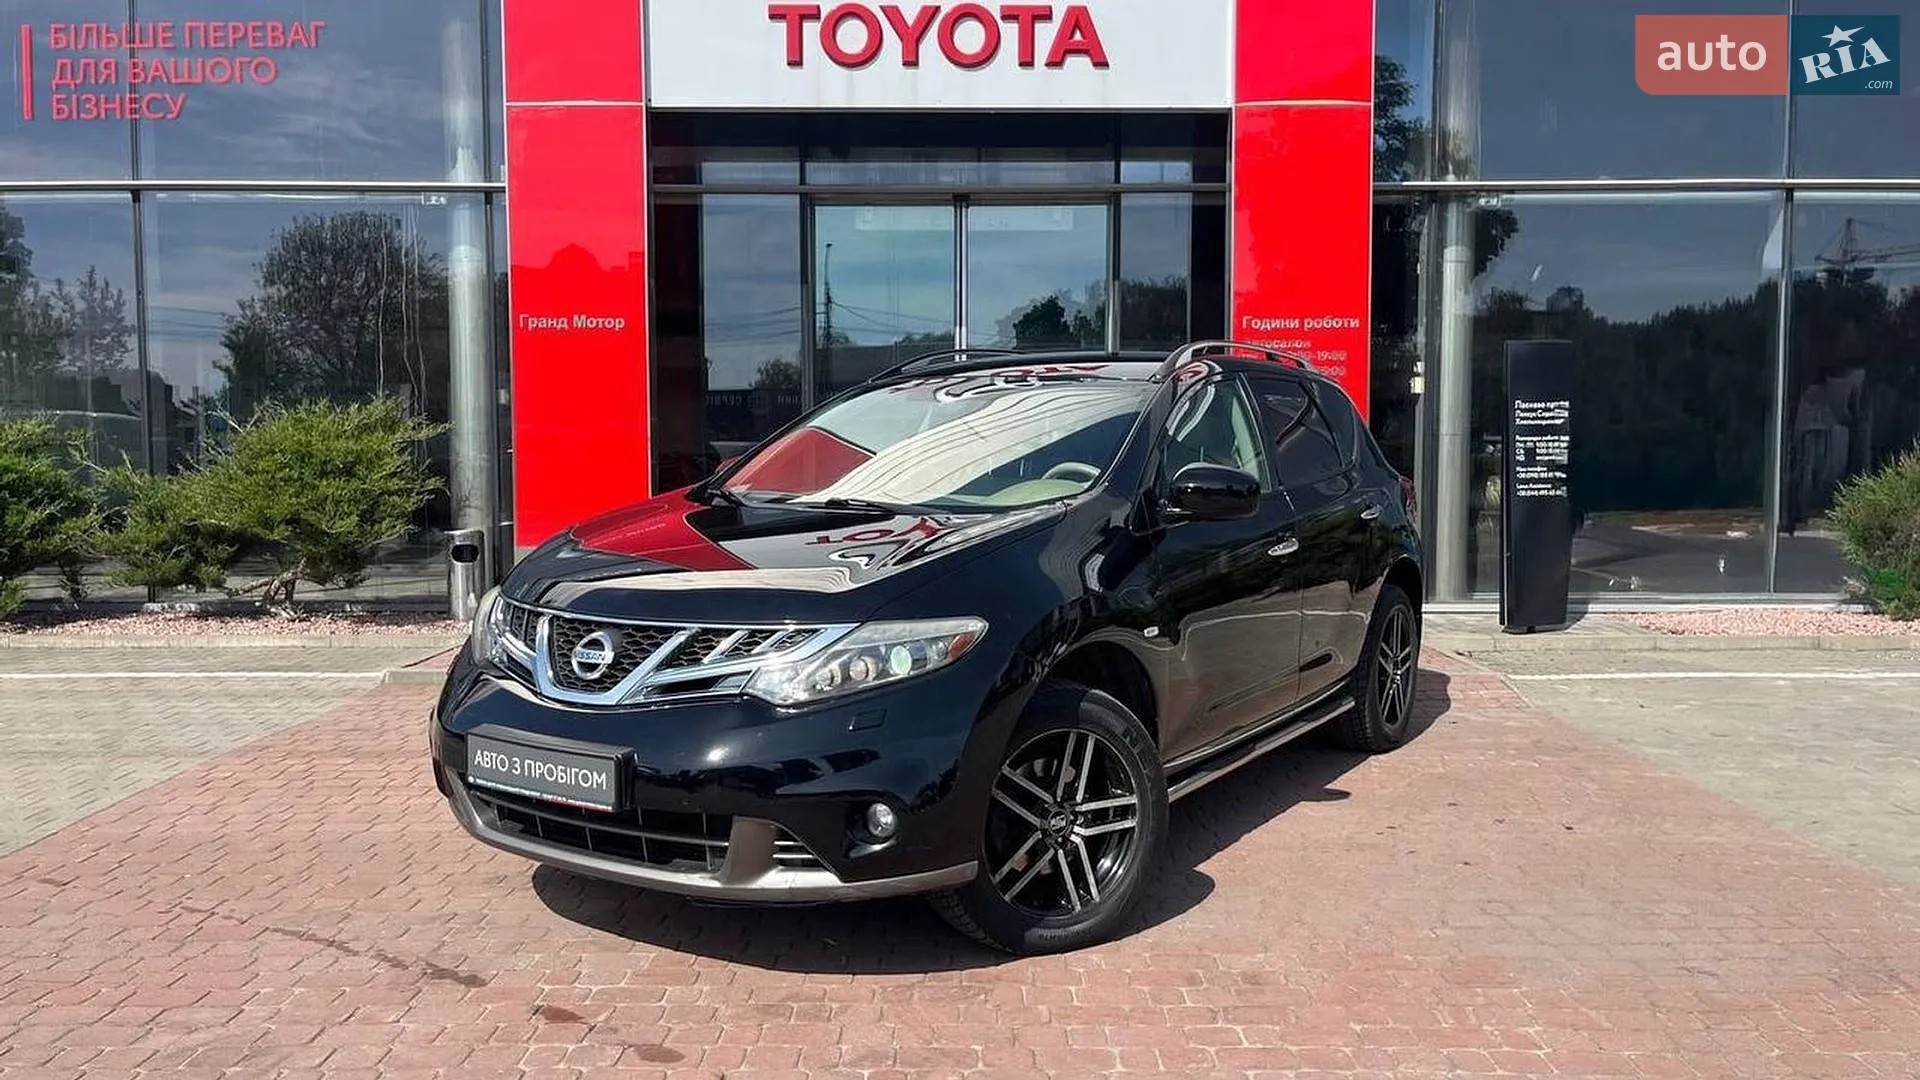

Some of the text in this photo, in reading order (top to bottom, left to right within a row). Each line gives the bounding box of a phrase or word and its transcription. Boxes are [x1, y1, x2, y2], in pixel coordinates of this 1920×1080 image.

[50, 20, 326, 49] БІЛЬШЕ ПЕРЕВАГ
[768, 2, 1110, 69] TOYOTA
[52, 56, 278, 90] ДЛЯ ВАШОГО
[51, 92, 188, 121] БІЗНЕСУ
[519, 314, 625, 331] Гранд Мотор
[1242, 315, 1360, 331] Години роботи
[474, 750, 509, 773] АВТО
[524, 759, 607, 791] ПРОБІГОМ
